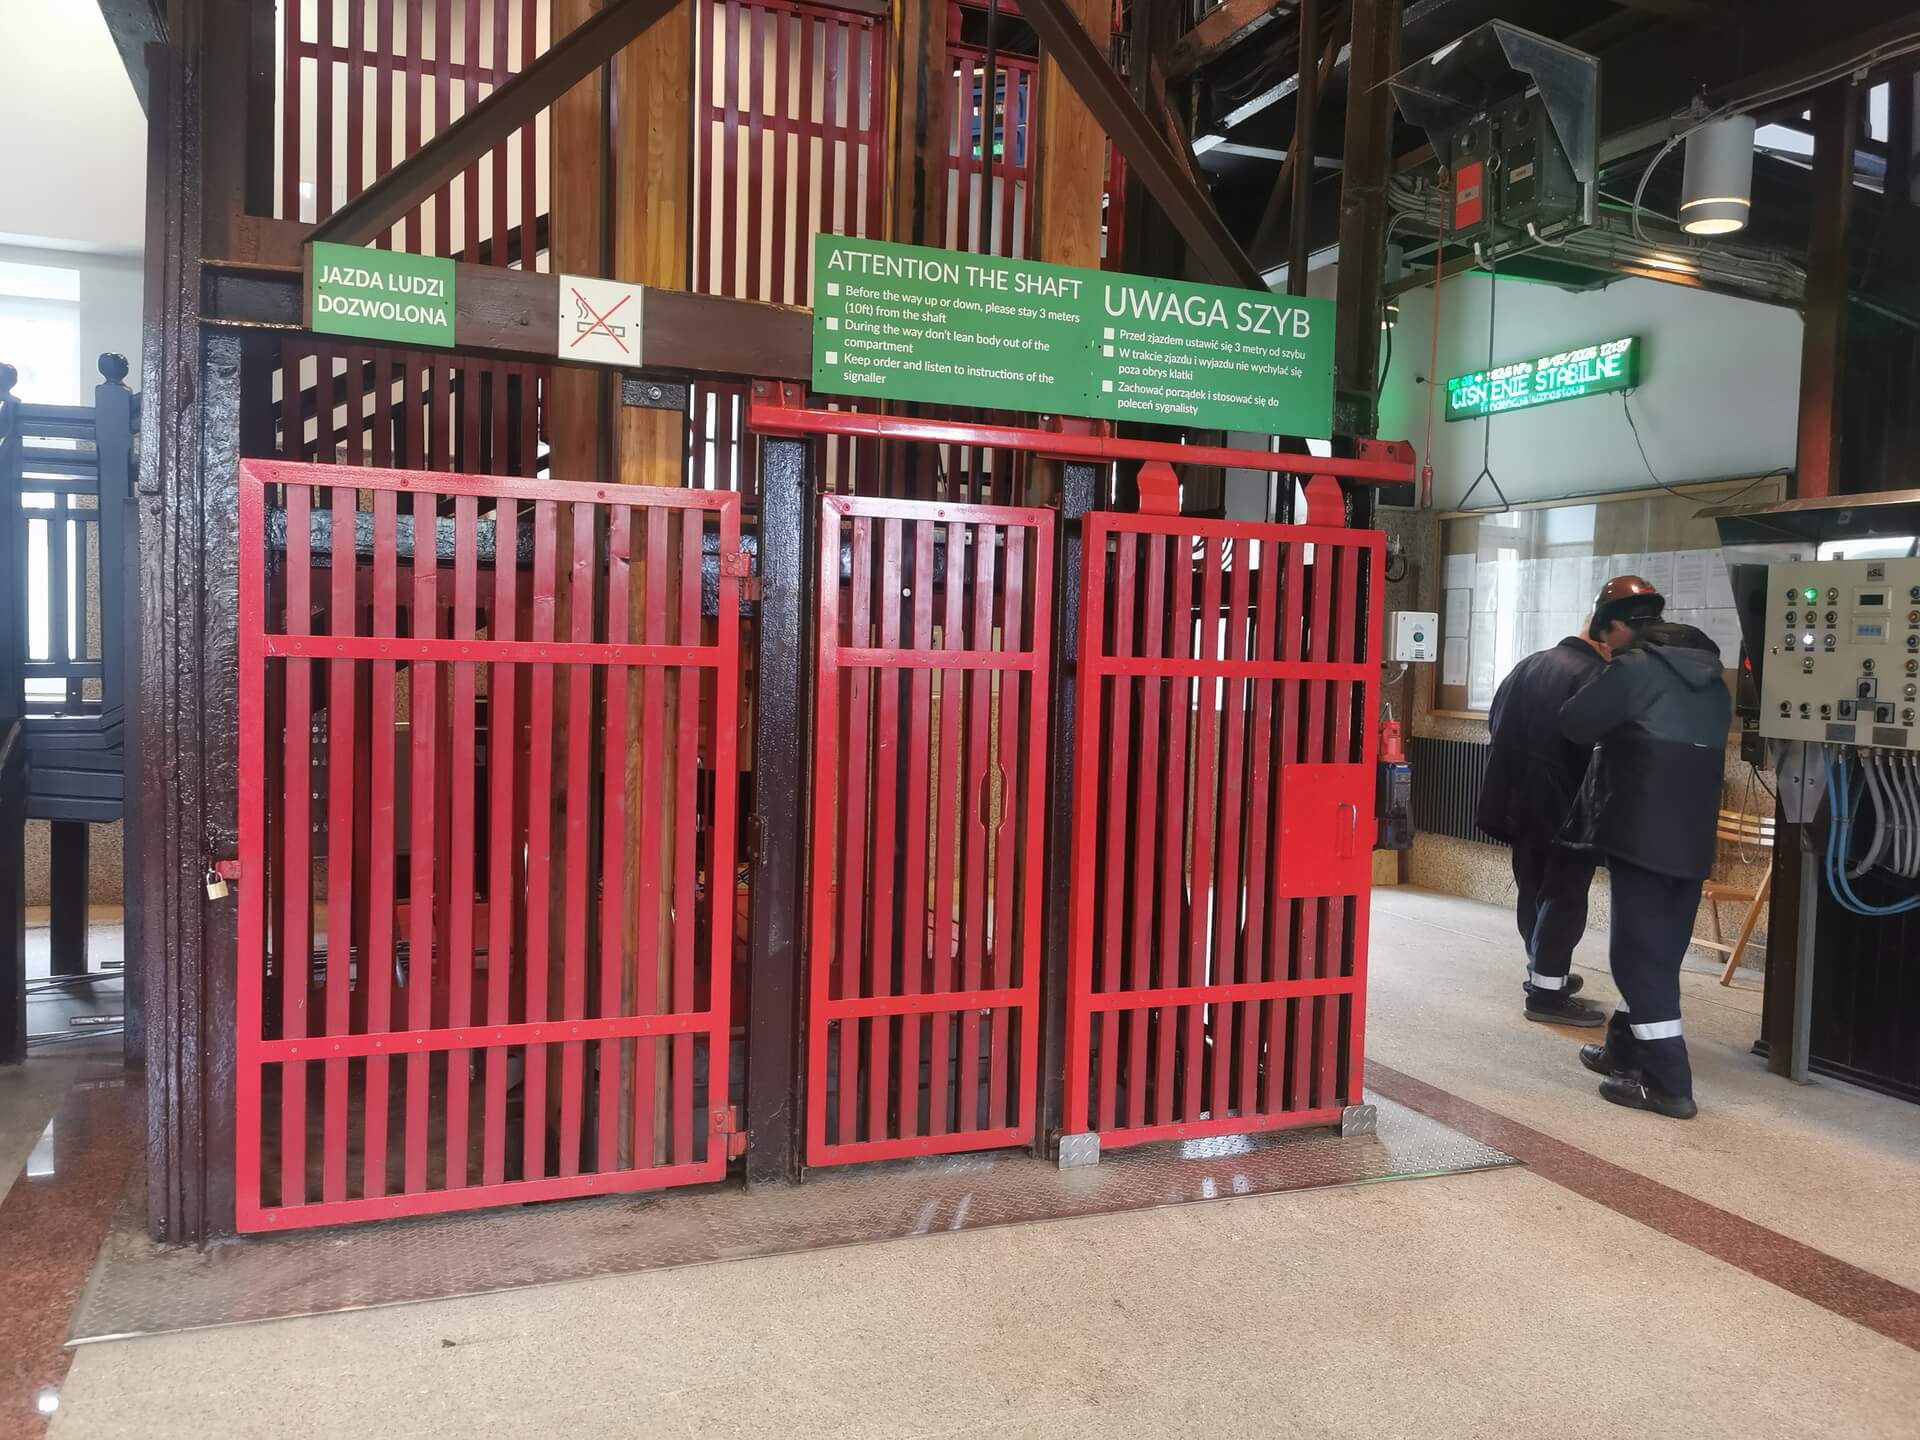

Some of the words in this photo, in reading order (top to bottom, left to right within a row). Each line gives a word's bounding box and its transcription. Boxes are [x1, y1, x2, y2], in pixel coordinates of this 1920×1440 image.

[319, 265, 384, 290] JAZDA
[388, 274, 444, 297] LUDZI
[827, 249, 959, 285] ATTENTION
[965, 266, 1009, 290] THE
[1014, 272, 1083, 300] SHAFT
[318, 294, 448, 327] DOZWOLONA
[845, 285, 880, 299] Before
[882, 289, 900, 301] the
[902, 294, 923, 306] way
[924, 296, 938, 307] up
[939, 298, 951, 307] or
[952, 298, 983, 312] down,
[985, 302, 1016, 315] please
[1018, 306, 1039, 319] stay
[1039, 308, 1046, 318] 3
[1048, 310, 1080, 323] meters
[845, 302, 874, 316] (10ft)
[875, 306, 900, 318] from
[903, 308, 920, 320] the
[921, 311, 947, 323] shaft
[1105, 285, 1229, 329] UWAGA
[1236, 302, 1310, 338] SZYB
[844, 338, 914, 353] compartment
[845, 319, 881, 335] During
[883, 323, 900, 335] the
[902, 327, 923, 339] way
[925, 327, 951, 340] don't
[953, 331, 974, 343] lean
[976, 333, 1001, 348] body
[1003, 338, 1020, 348] out
[1021, 339, 1033, 349] of
[1034, 340, 1050, 351] the
[1120, 329, 1146, 342] Przed
[1147, 333, 1183, 346] zjazdem
[1185, 338, 1218, 350] ustawić
[1220, 342, 1233, 353] się
[1235, 342, 1241, 352] 3
[1243, 345, 1269, 357] metry
[1269, 347, 1280, 357] od
[1282, 349, 1306, 360] szybu
[843, 370, 887, 384] signaller
[844, 352, 871, 367] Keep
[873, 356, 901, 368] order
[903, 360, 922, 371] and
[924, 361, 952, 373] listen
[954, 364, 965, 375] to
[967, 365, 1025, 381] instructions
[1026, 371, 1038, 382] of
[1038, 373, 1055, 384] the
[1119, 348, 1130, 358] W
[1132, 350, 1163, 362] trakcie
[1164, 353, 1192, 365] zjazdu
[1194, 356, 1198, 365] i
[1199, 358, 1234, 369] wyjazdu
[1236, 361, 1249, 371] nie
[1250, 362, 1289, 376] wychylać
[1290, 367, 1303, 379] się
[1119, 365, 1140, 375] poza
[1142, 366, 1167, 378] obrys
[1169, 369, 1193, 381] klatki
[1535, 354, 1621, 391] STABILNE
[1118, 381, 1164, 395] Zachować
[1165, 388, 1207, 400] porządek
[1208, 391, 1211, 400] i
[1212, 392, 1253, 405] stosować
[1254, 396, 1266, 407] się
[1268, 397, 1279, 407] do
[1118, 398, 1153, 410] poleceń
[1155, 402, 1198, 416] sygnalisty
